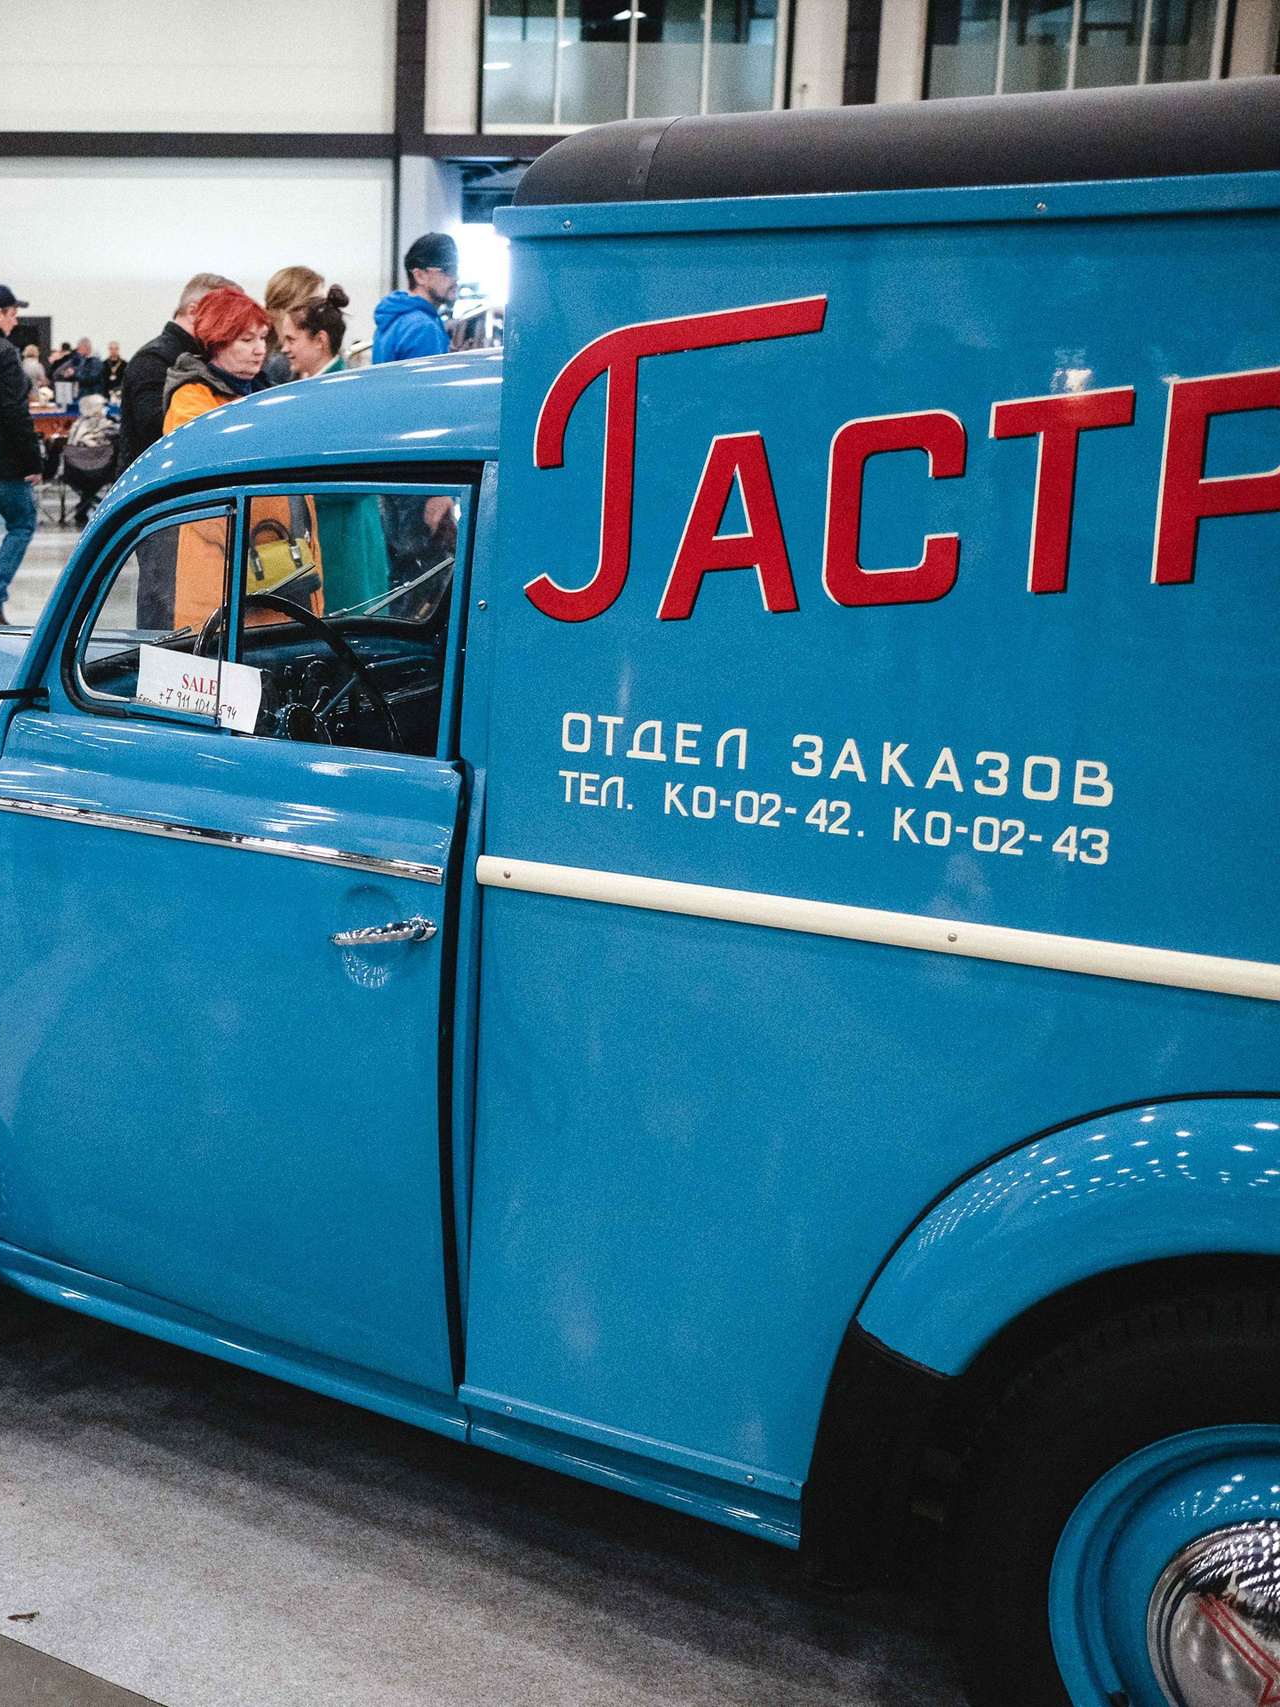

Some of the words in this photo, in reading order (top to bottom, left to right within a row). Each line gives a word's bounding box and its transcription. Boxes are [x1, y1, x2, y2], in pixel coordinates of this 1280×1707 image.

[181, 673, 219, 697] SALE
[561, 711, 748, 770] ОТДЕЛ
[791, 733, 1114, 807] ЗАКАЗОВ
[558, 769, 634, 811] ТЕЛ.
[892, 806, 1110, 866] КО-02-43
